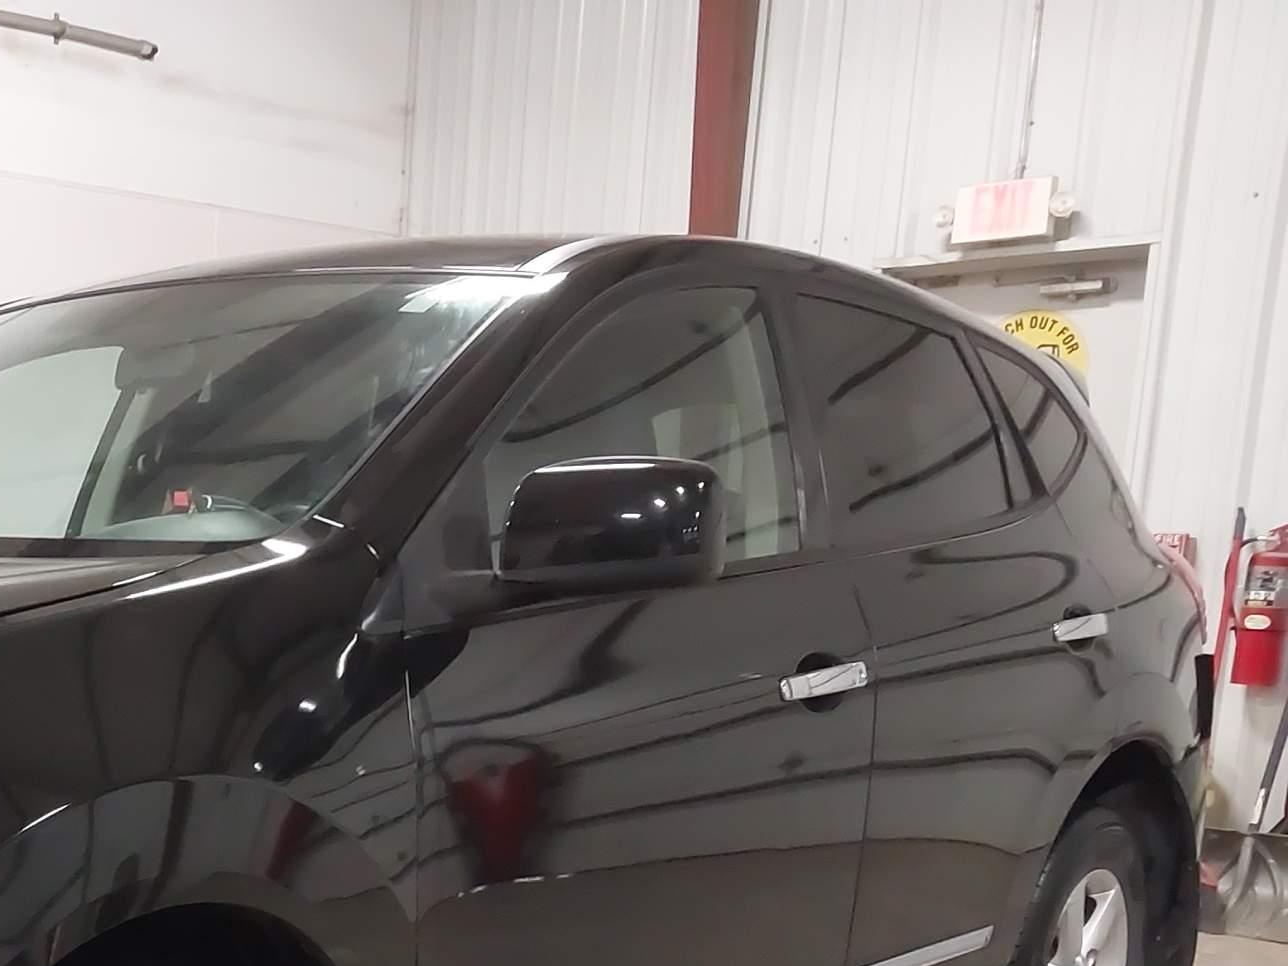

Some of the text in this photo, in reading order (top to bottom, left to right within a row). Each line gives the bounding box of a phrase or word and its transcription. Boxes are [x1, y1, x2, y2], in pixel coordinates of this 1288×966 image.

[969, 181, 1032, 235] EXIT
[1029, 315, 1059, 332] OUT
[1056, 326, 1080, 354] FOR
